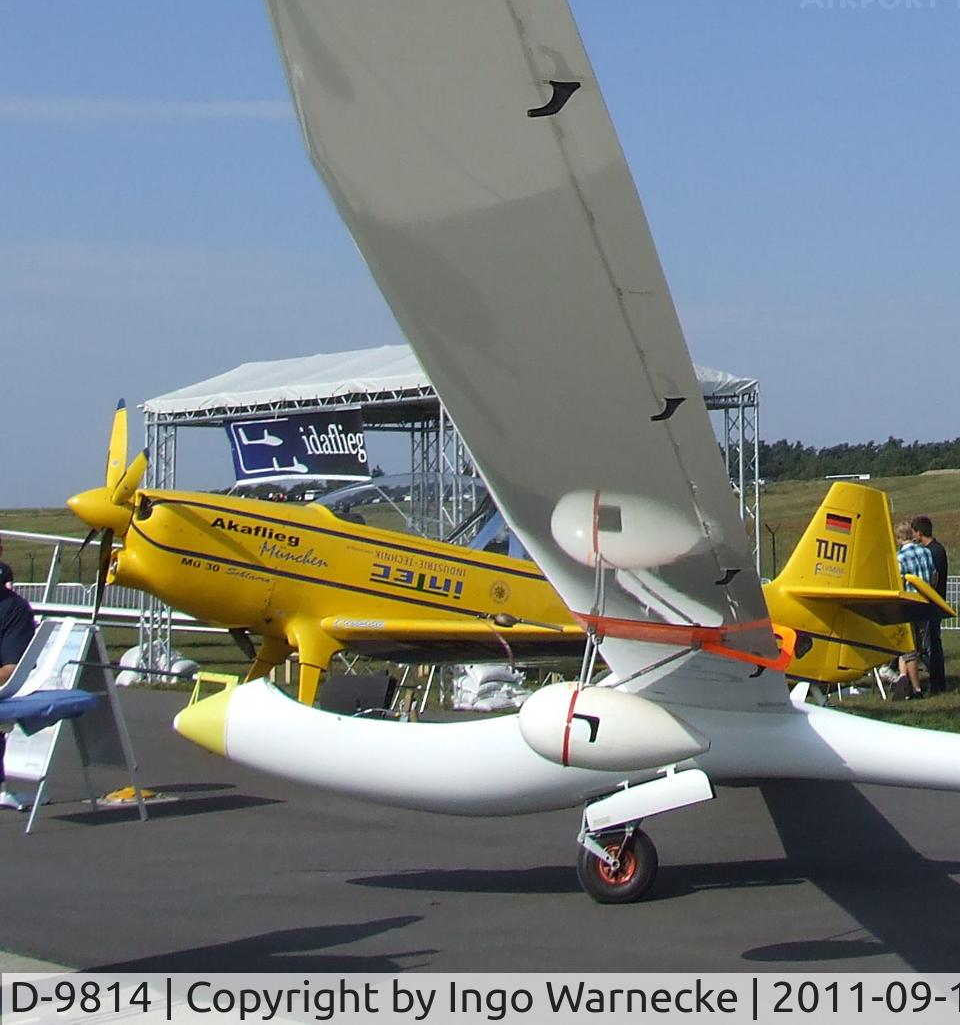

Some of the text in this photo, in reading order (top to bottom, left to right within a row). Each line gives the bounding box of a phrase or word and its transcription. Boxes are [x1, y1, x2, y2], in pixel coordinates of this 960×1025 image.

[300, 424, 367, 462] idaflieg
[210, 517, 300, 547] Akaflieg
[259, 541, 329, 567] München
[816, 538, 847, 563] TUM
[181, 557, 201, 568] Mü
[205, 563, 220, 572] 30
